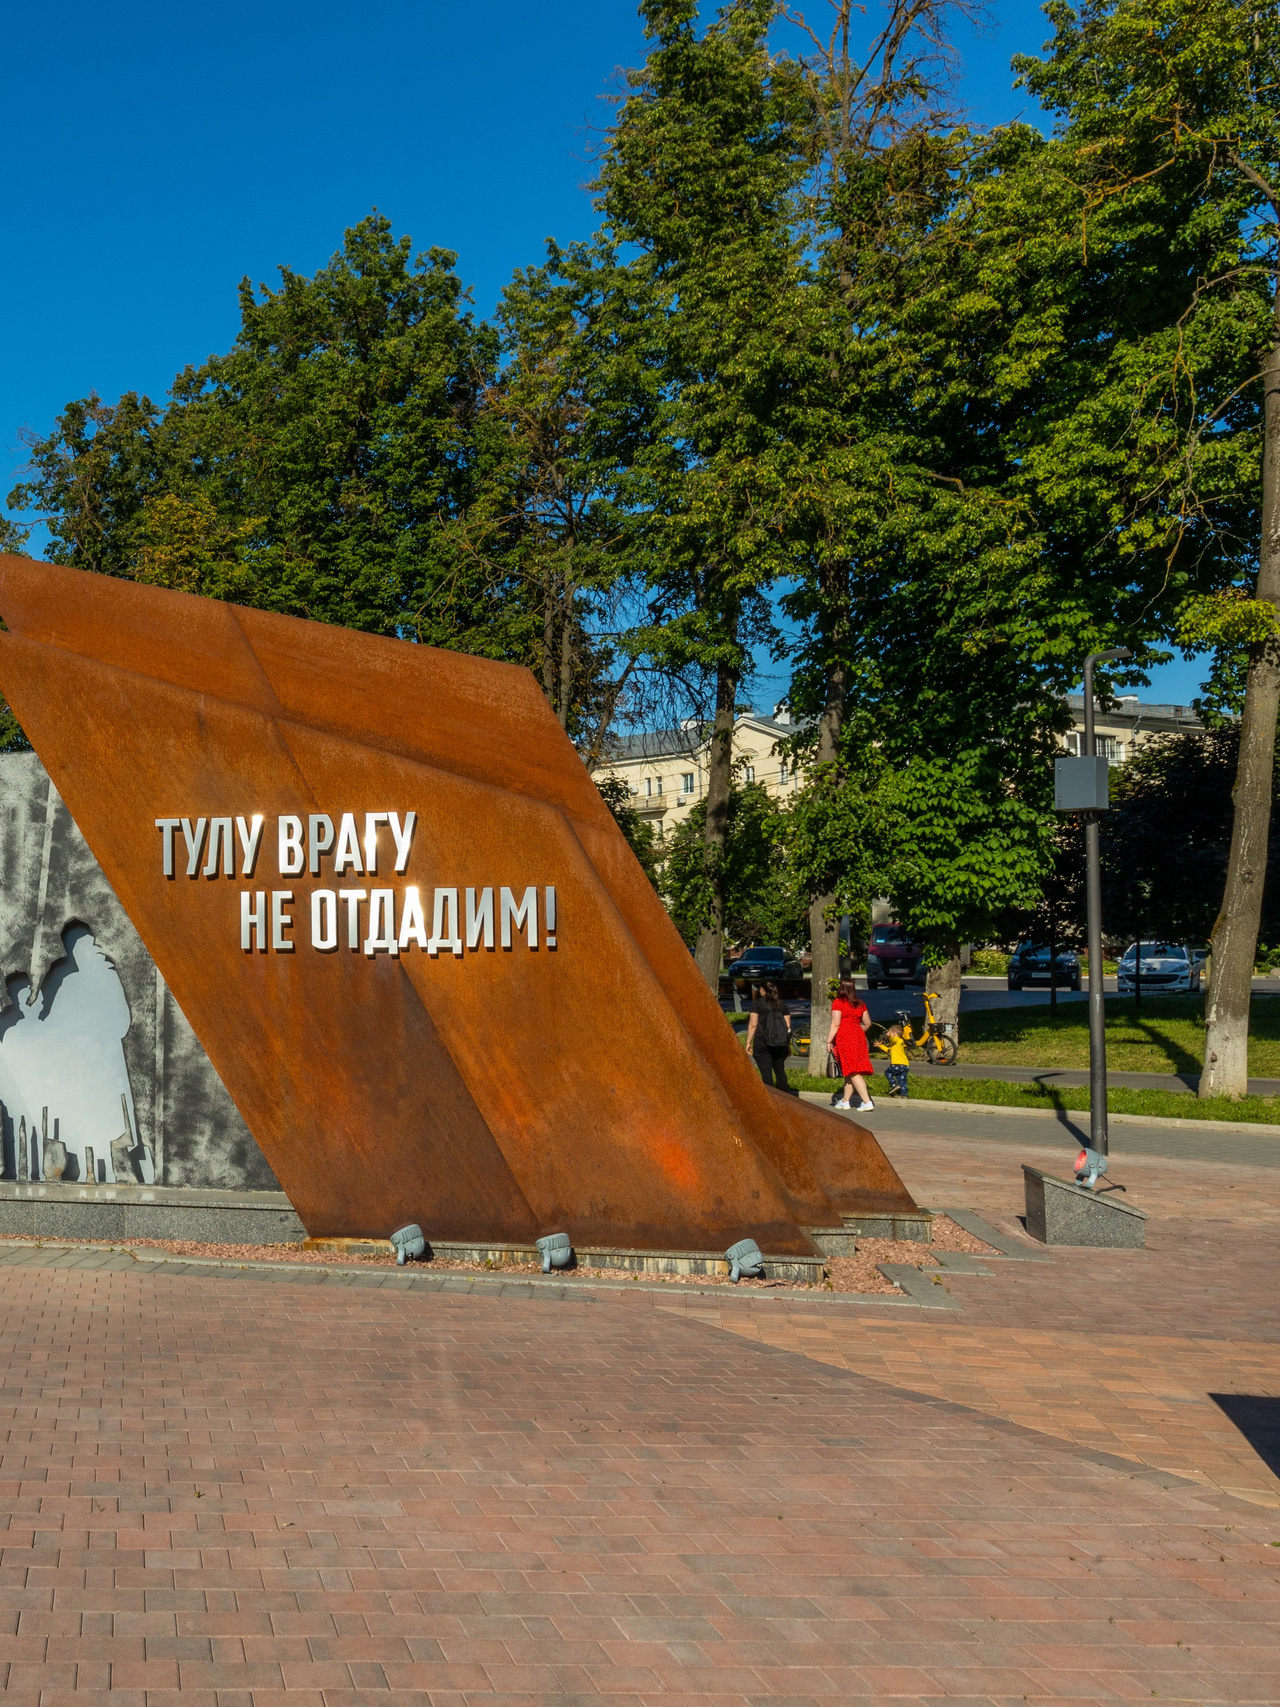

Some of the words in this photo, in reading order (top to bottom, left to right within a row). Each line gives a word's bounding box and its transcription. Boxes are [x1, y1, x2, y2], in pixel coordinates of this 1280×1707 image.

[155, 814, 264, 876] ТУЛУ
[278, 811, 417, 873] ВРАГУ
[240, 890, 295, 950] НЕ
[311, 886, 557, 956] ОТДАДИМ!
